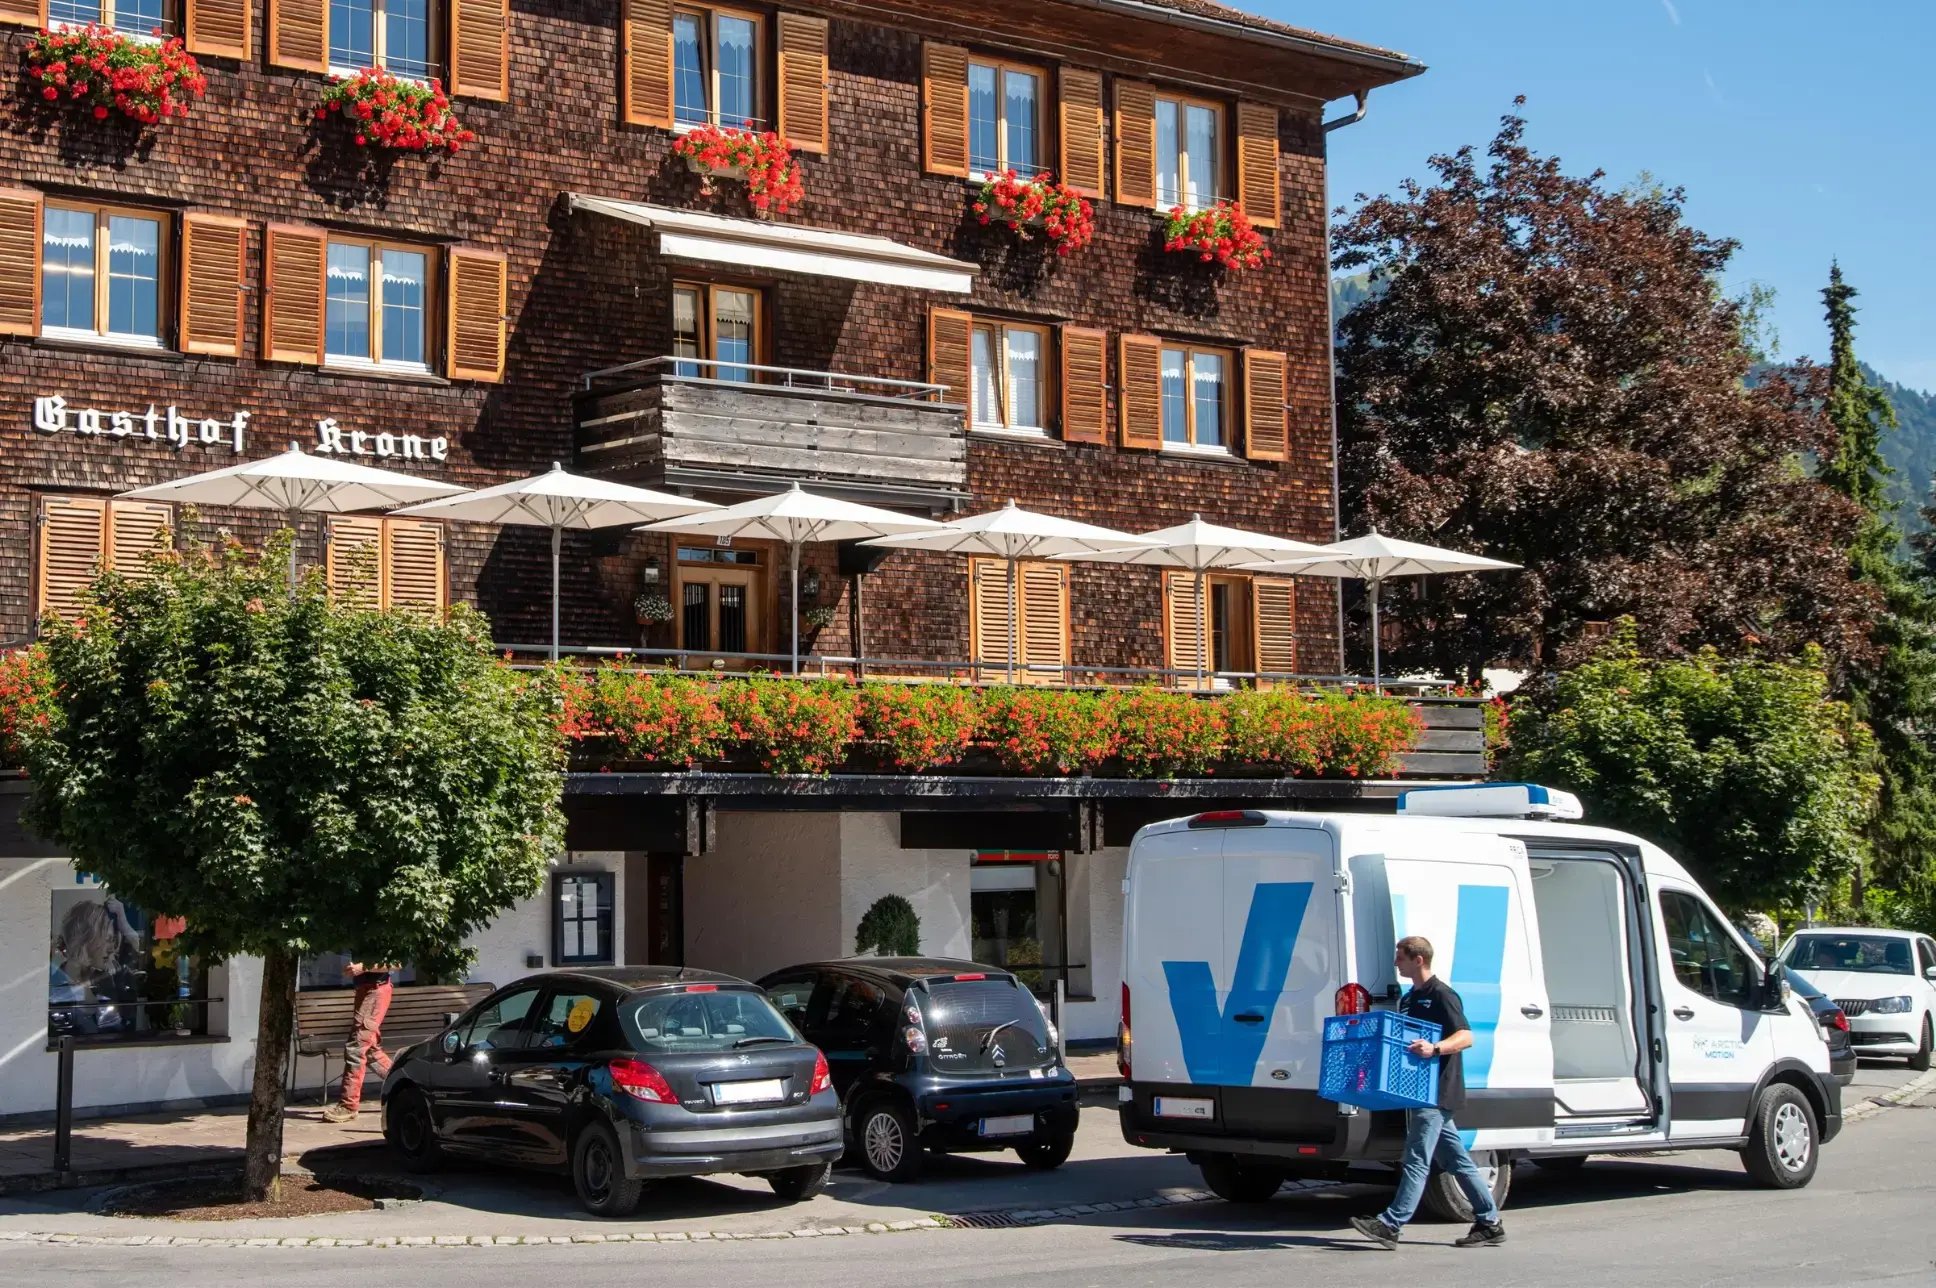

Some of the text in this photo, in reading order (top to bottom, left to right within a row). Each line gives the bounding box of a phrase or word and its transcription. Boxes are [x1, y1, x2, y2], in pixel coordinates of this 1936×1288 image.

[34, 394, 448, 461] Gasthof Krone
[1704, 1050, 1735, 1059] MOTION
